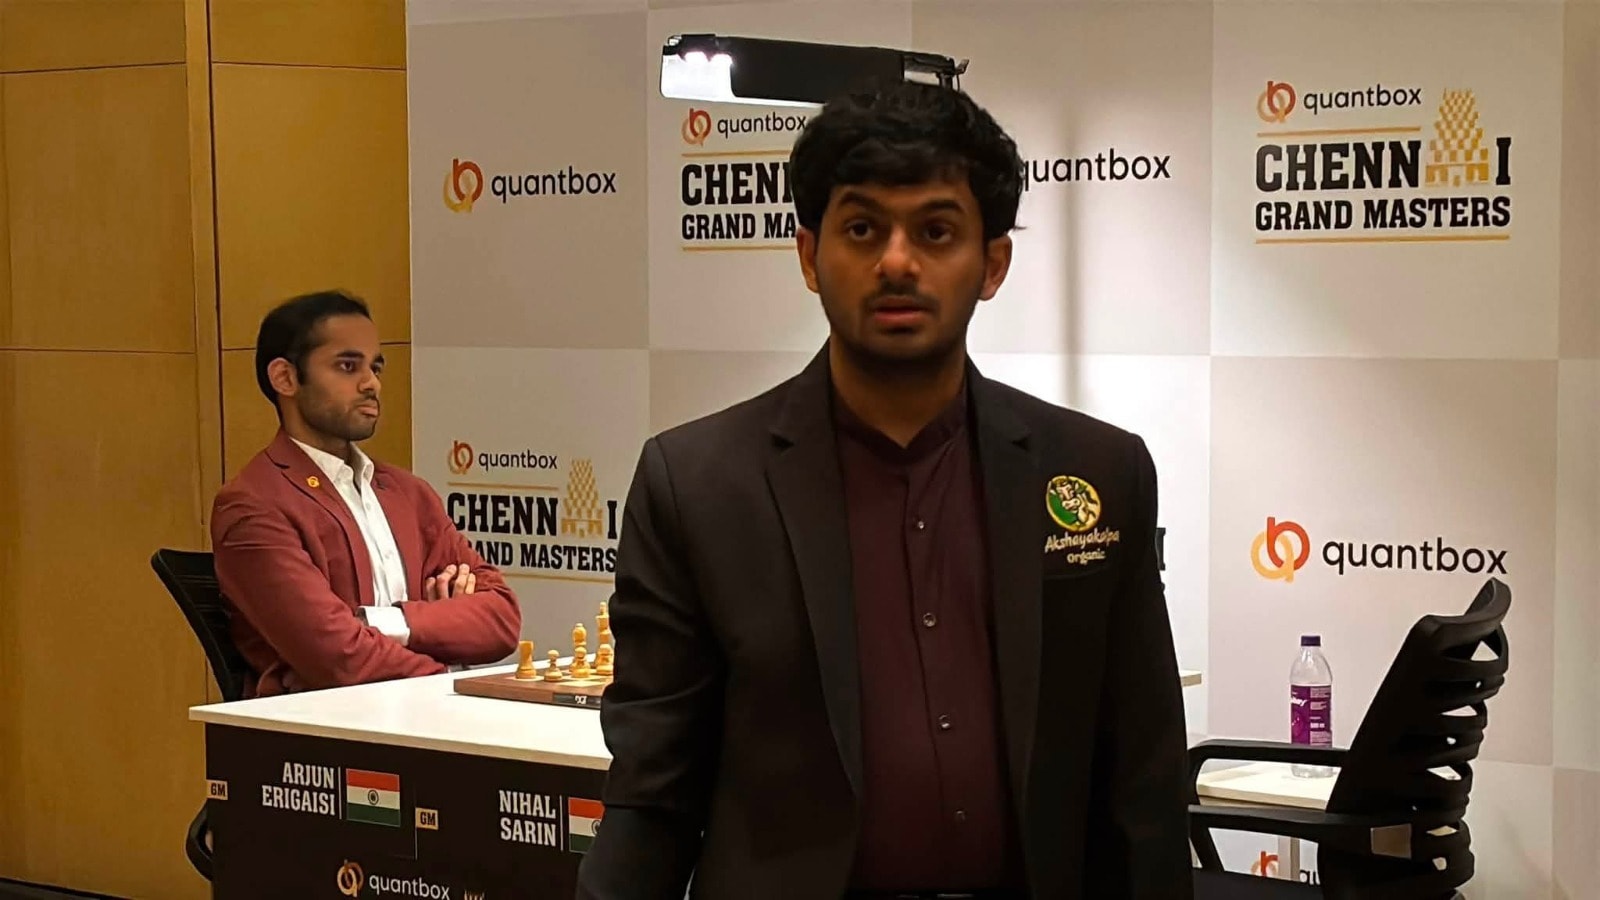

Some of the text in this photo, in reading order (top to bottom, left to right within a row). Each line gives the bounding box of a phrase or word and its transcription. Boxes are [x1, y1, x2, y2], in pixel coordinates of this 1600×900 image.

[1303, 84, 1422, 115] quantbox
[717, 112, 807, 139] quantbox
[491, 166, 617, 203] quantbox
[682, 214, 756, 239] GRAND
[1256, 196, 1511, 231] GRAND MASTERS
[478, 449, 558, 471] quantbox
[468, 540, 617, 573] AND MASTERS
[1067, 548, 1106, 565] organic
[1322, 537, 1508, 575] quantbox
[210, 782, 226, 797] GM
[282, 761, 334, 789] ARJUN
[261, 784, 335, 816] ERIGAISI
[499, 789, 556, 819] NIHAL
[420, 811, 436, 827] GM
[500, 817, 557, 847] SARIN
[369, 871, 450, 900] quantbox
